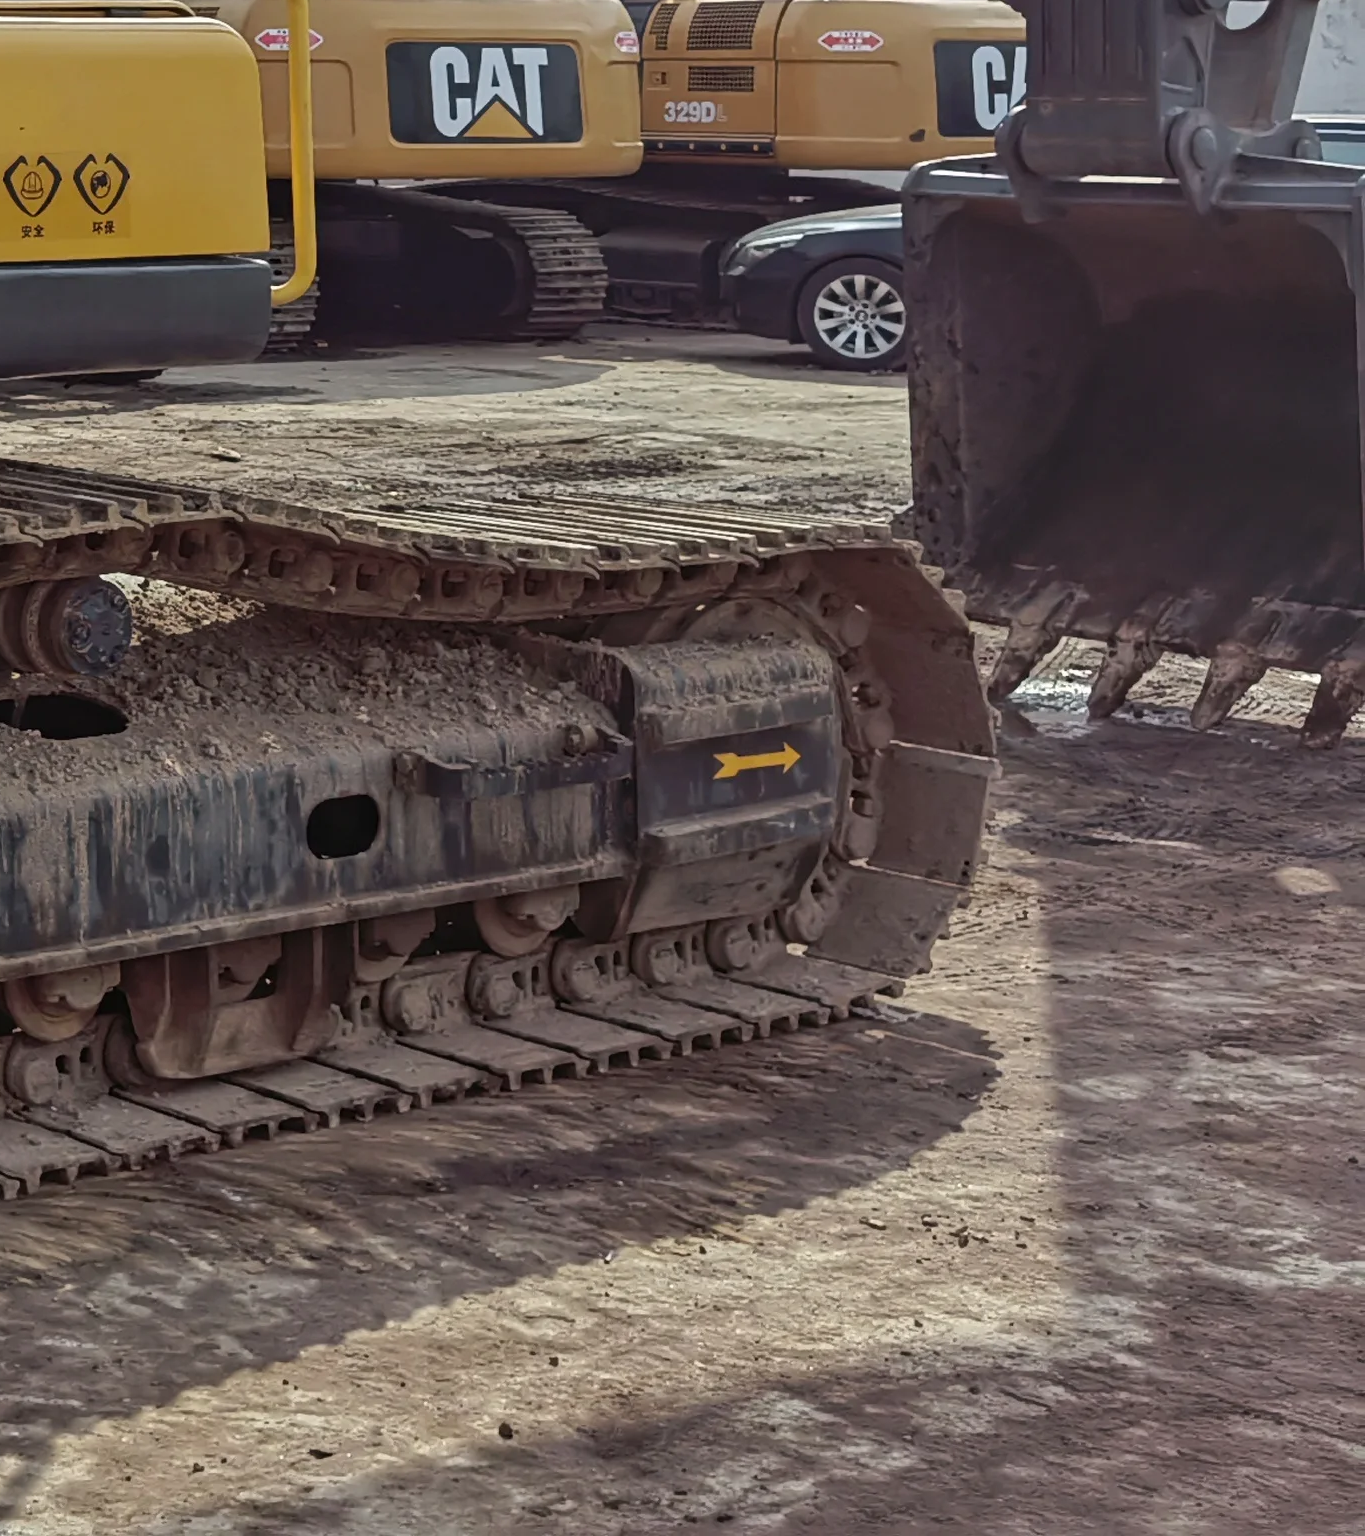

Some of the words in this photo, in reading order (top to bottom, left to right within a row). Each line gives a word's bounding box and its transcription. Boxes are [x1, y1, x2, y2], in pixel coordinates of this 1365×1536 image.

[429, 46, 549, 138] CAT
[21, 224, 45, 239] 安全
[92, 221, 116, 235] 环保
